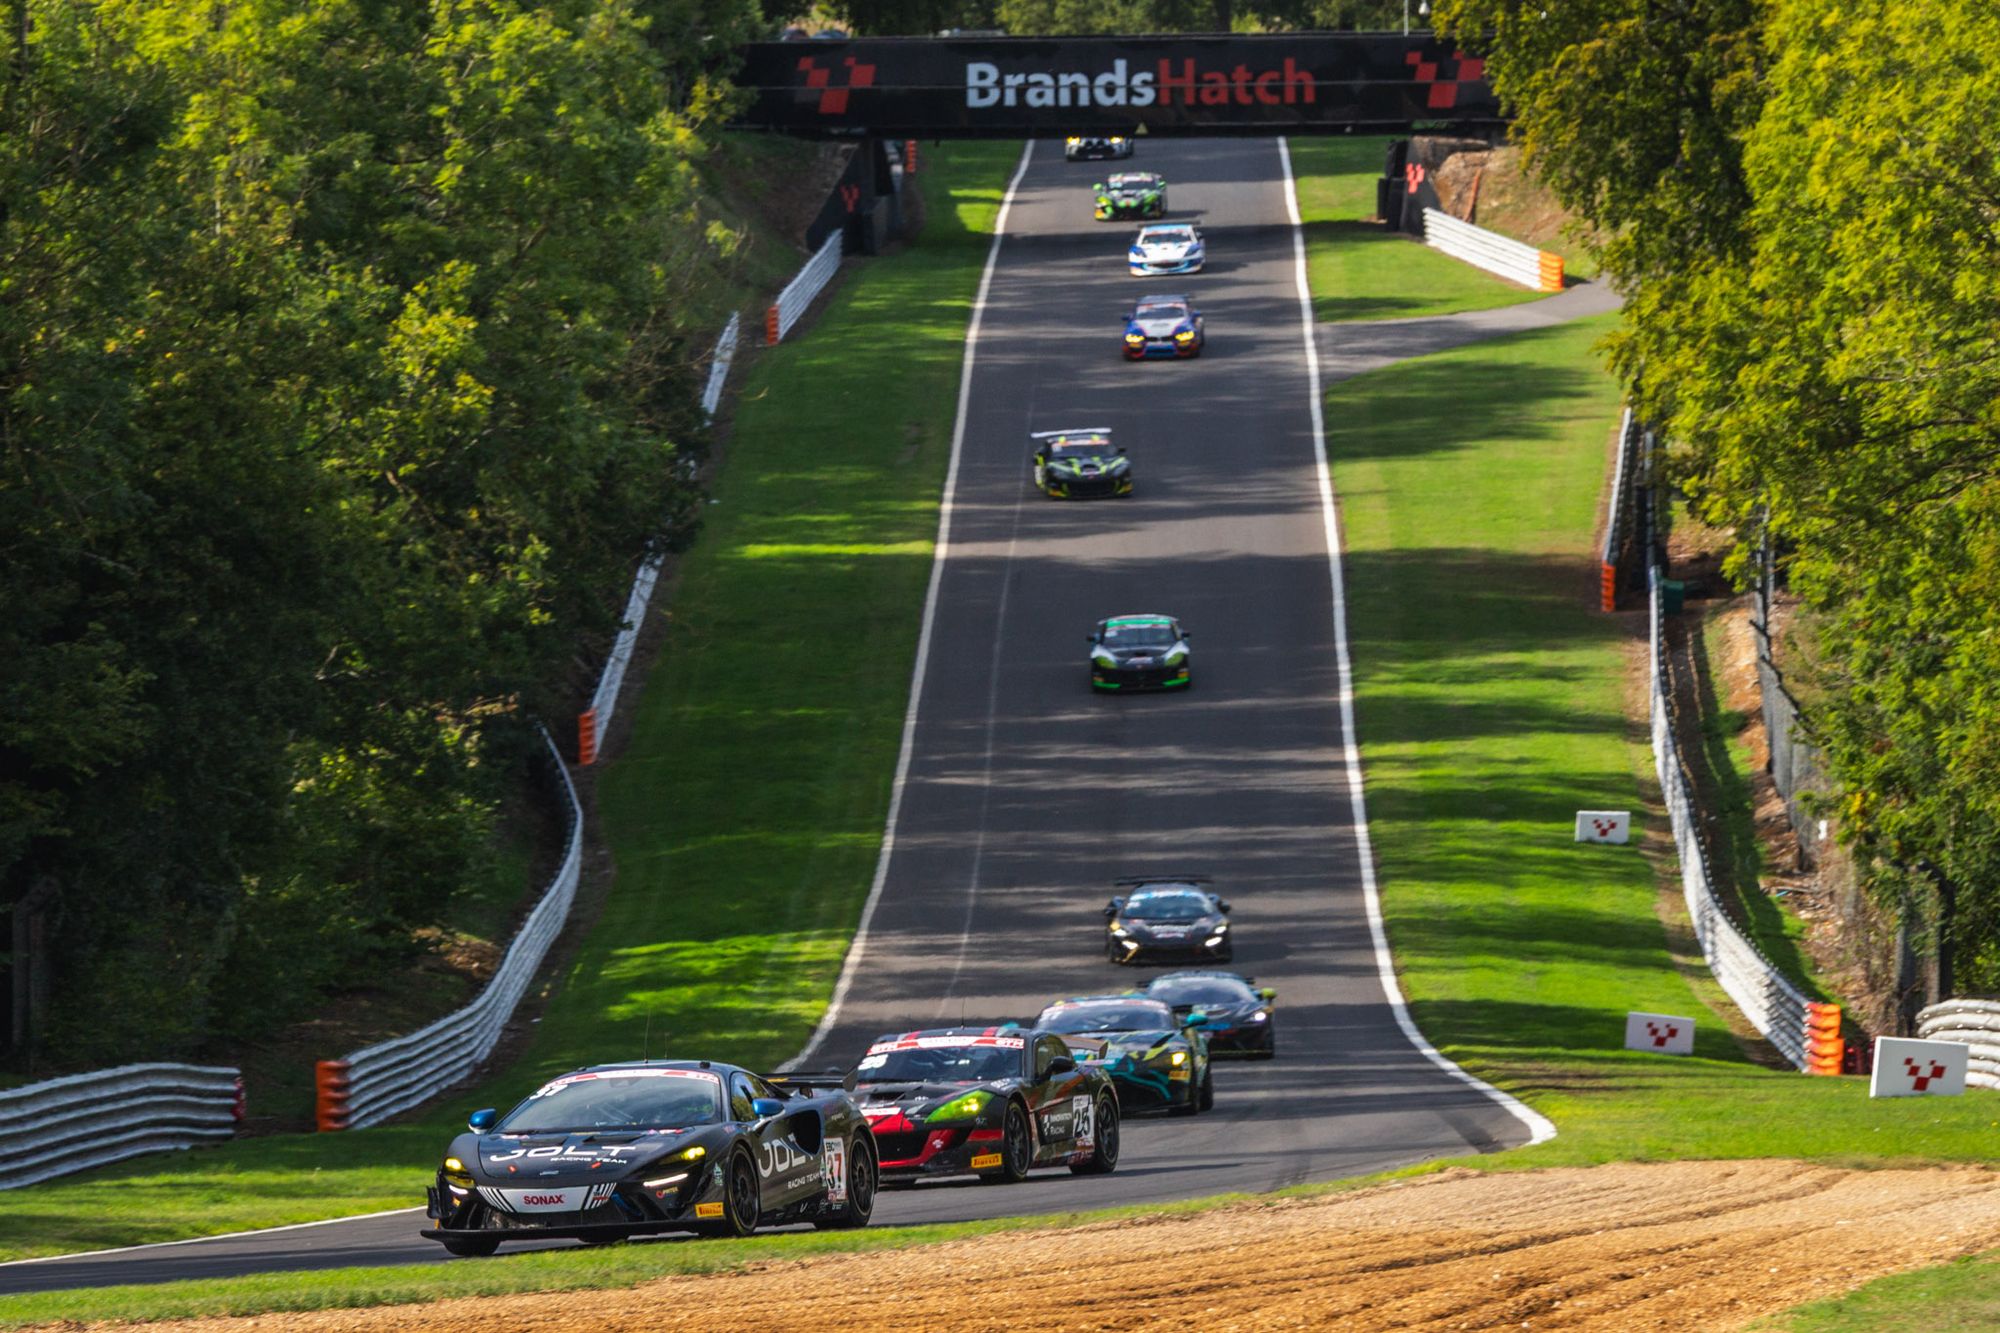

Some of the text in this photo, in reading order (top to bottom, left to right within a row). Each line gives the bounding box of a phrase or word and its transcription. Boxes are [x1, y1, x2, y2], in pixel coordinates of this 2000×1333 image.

[1074, 1107, 1091, 1137] 25
[489, 1145, 636, 1161] JOLT
[826, 1152, 843, 1189] 37
[523, 1194, 564, 1206] SONAX
